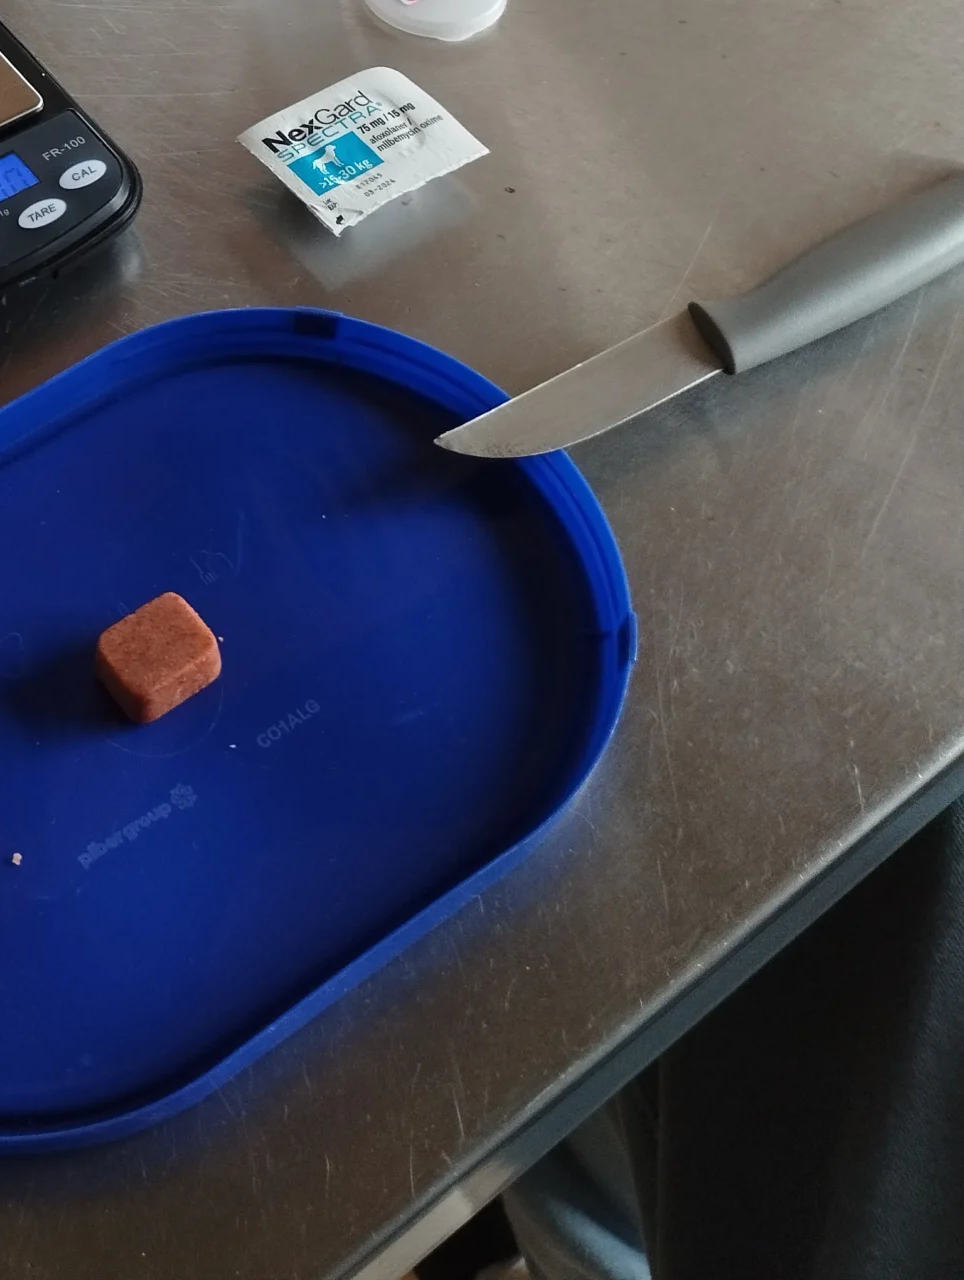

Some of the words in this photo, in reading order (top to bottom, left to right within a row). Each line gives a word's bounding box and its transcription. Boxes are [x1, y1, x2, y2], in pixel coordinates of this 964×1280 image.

[262, 90, 373, 154] NexGard
[357, 123, 371, 134] 75
[371, 116, 386, 129] mg
[389, 109, 401, 120] 15
[399, 102, 415, 114] mg
[420, 114, 444, 129] oxime
[42, 136, 86, 161] FR-100
[71, 165, 97, 182] CAL
[357, 158, 374, 172] kg
[27, 204, 57, 223] TARE
